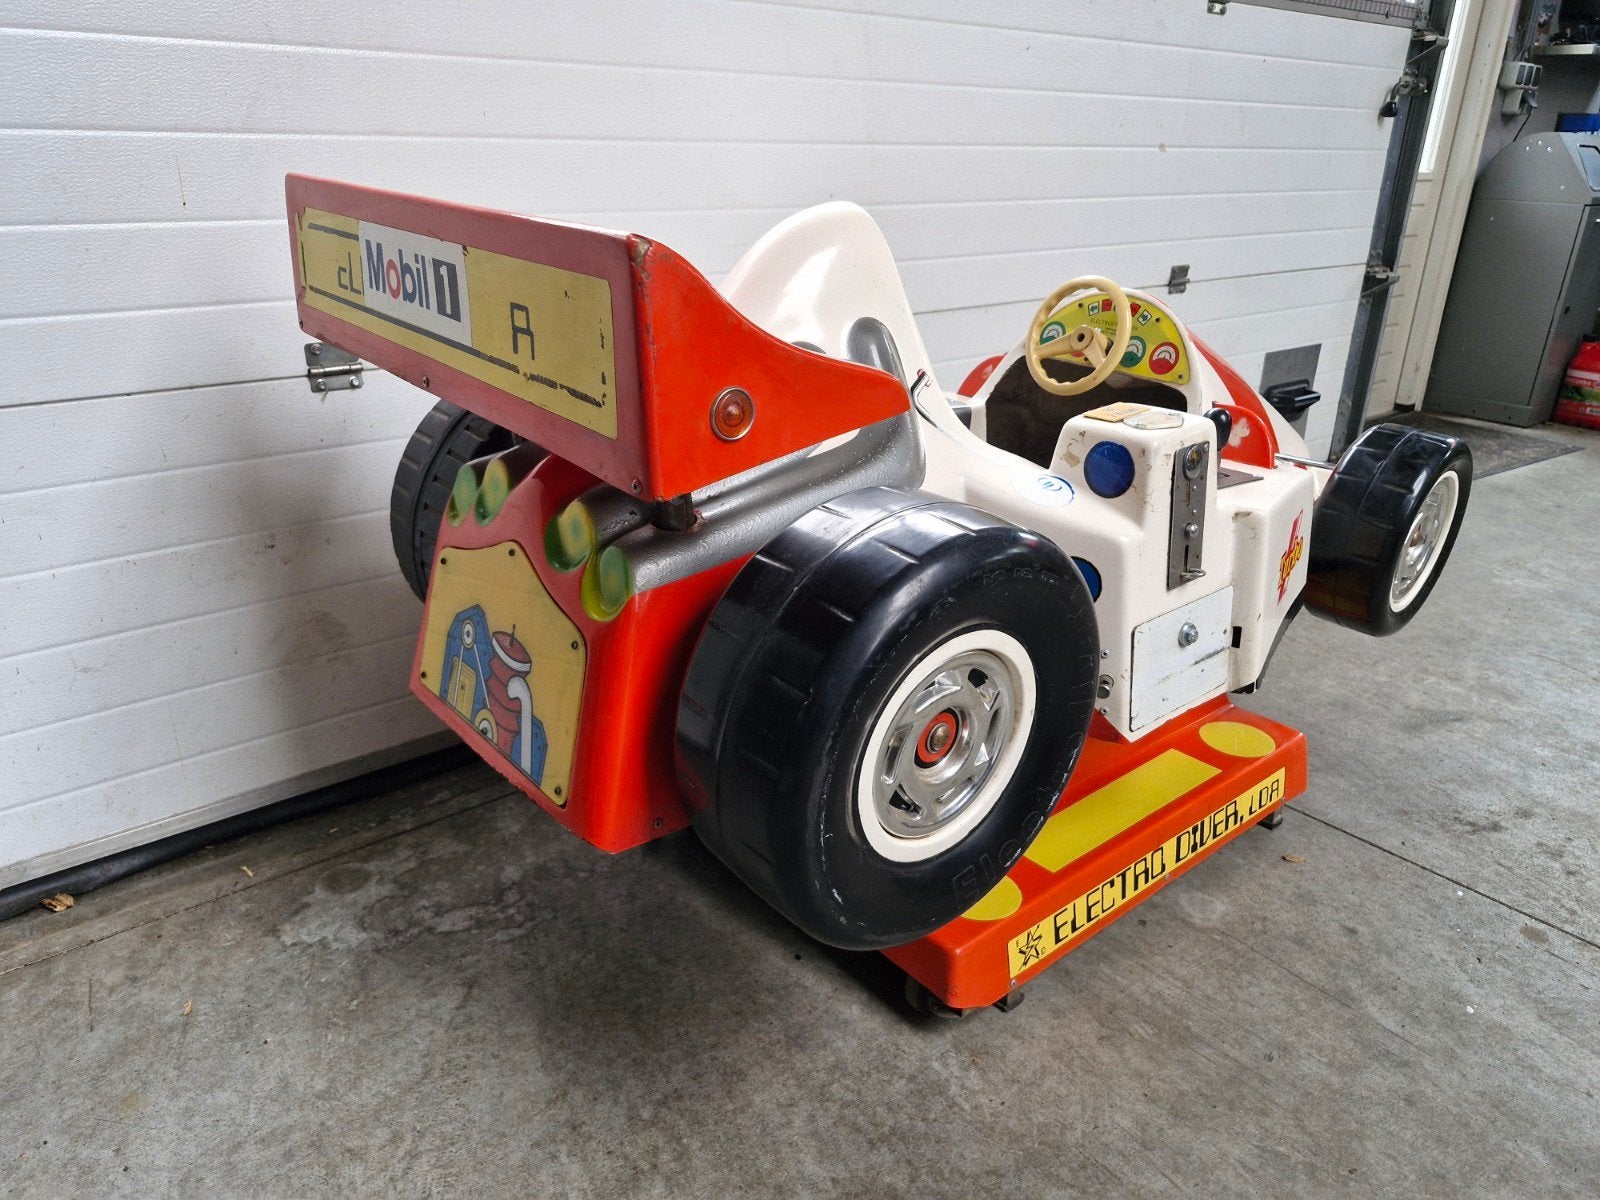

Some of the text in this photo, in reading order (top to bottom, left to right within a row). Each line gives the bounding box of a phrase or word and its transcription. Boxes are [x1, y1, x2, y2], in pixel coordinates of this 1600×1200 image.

[365, 239, 431, 309] Mobil
[1054, 846, 1166, 944] ELECTRO
[1249, 778, 1280, 815] LDA
